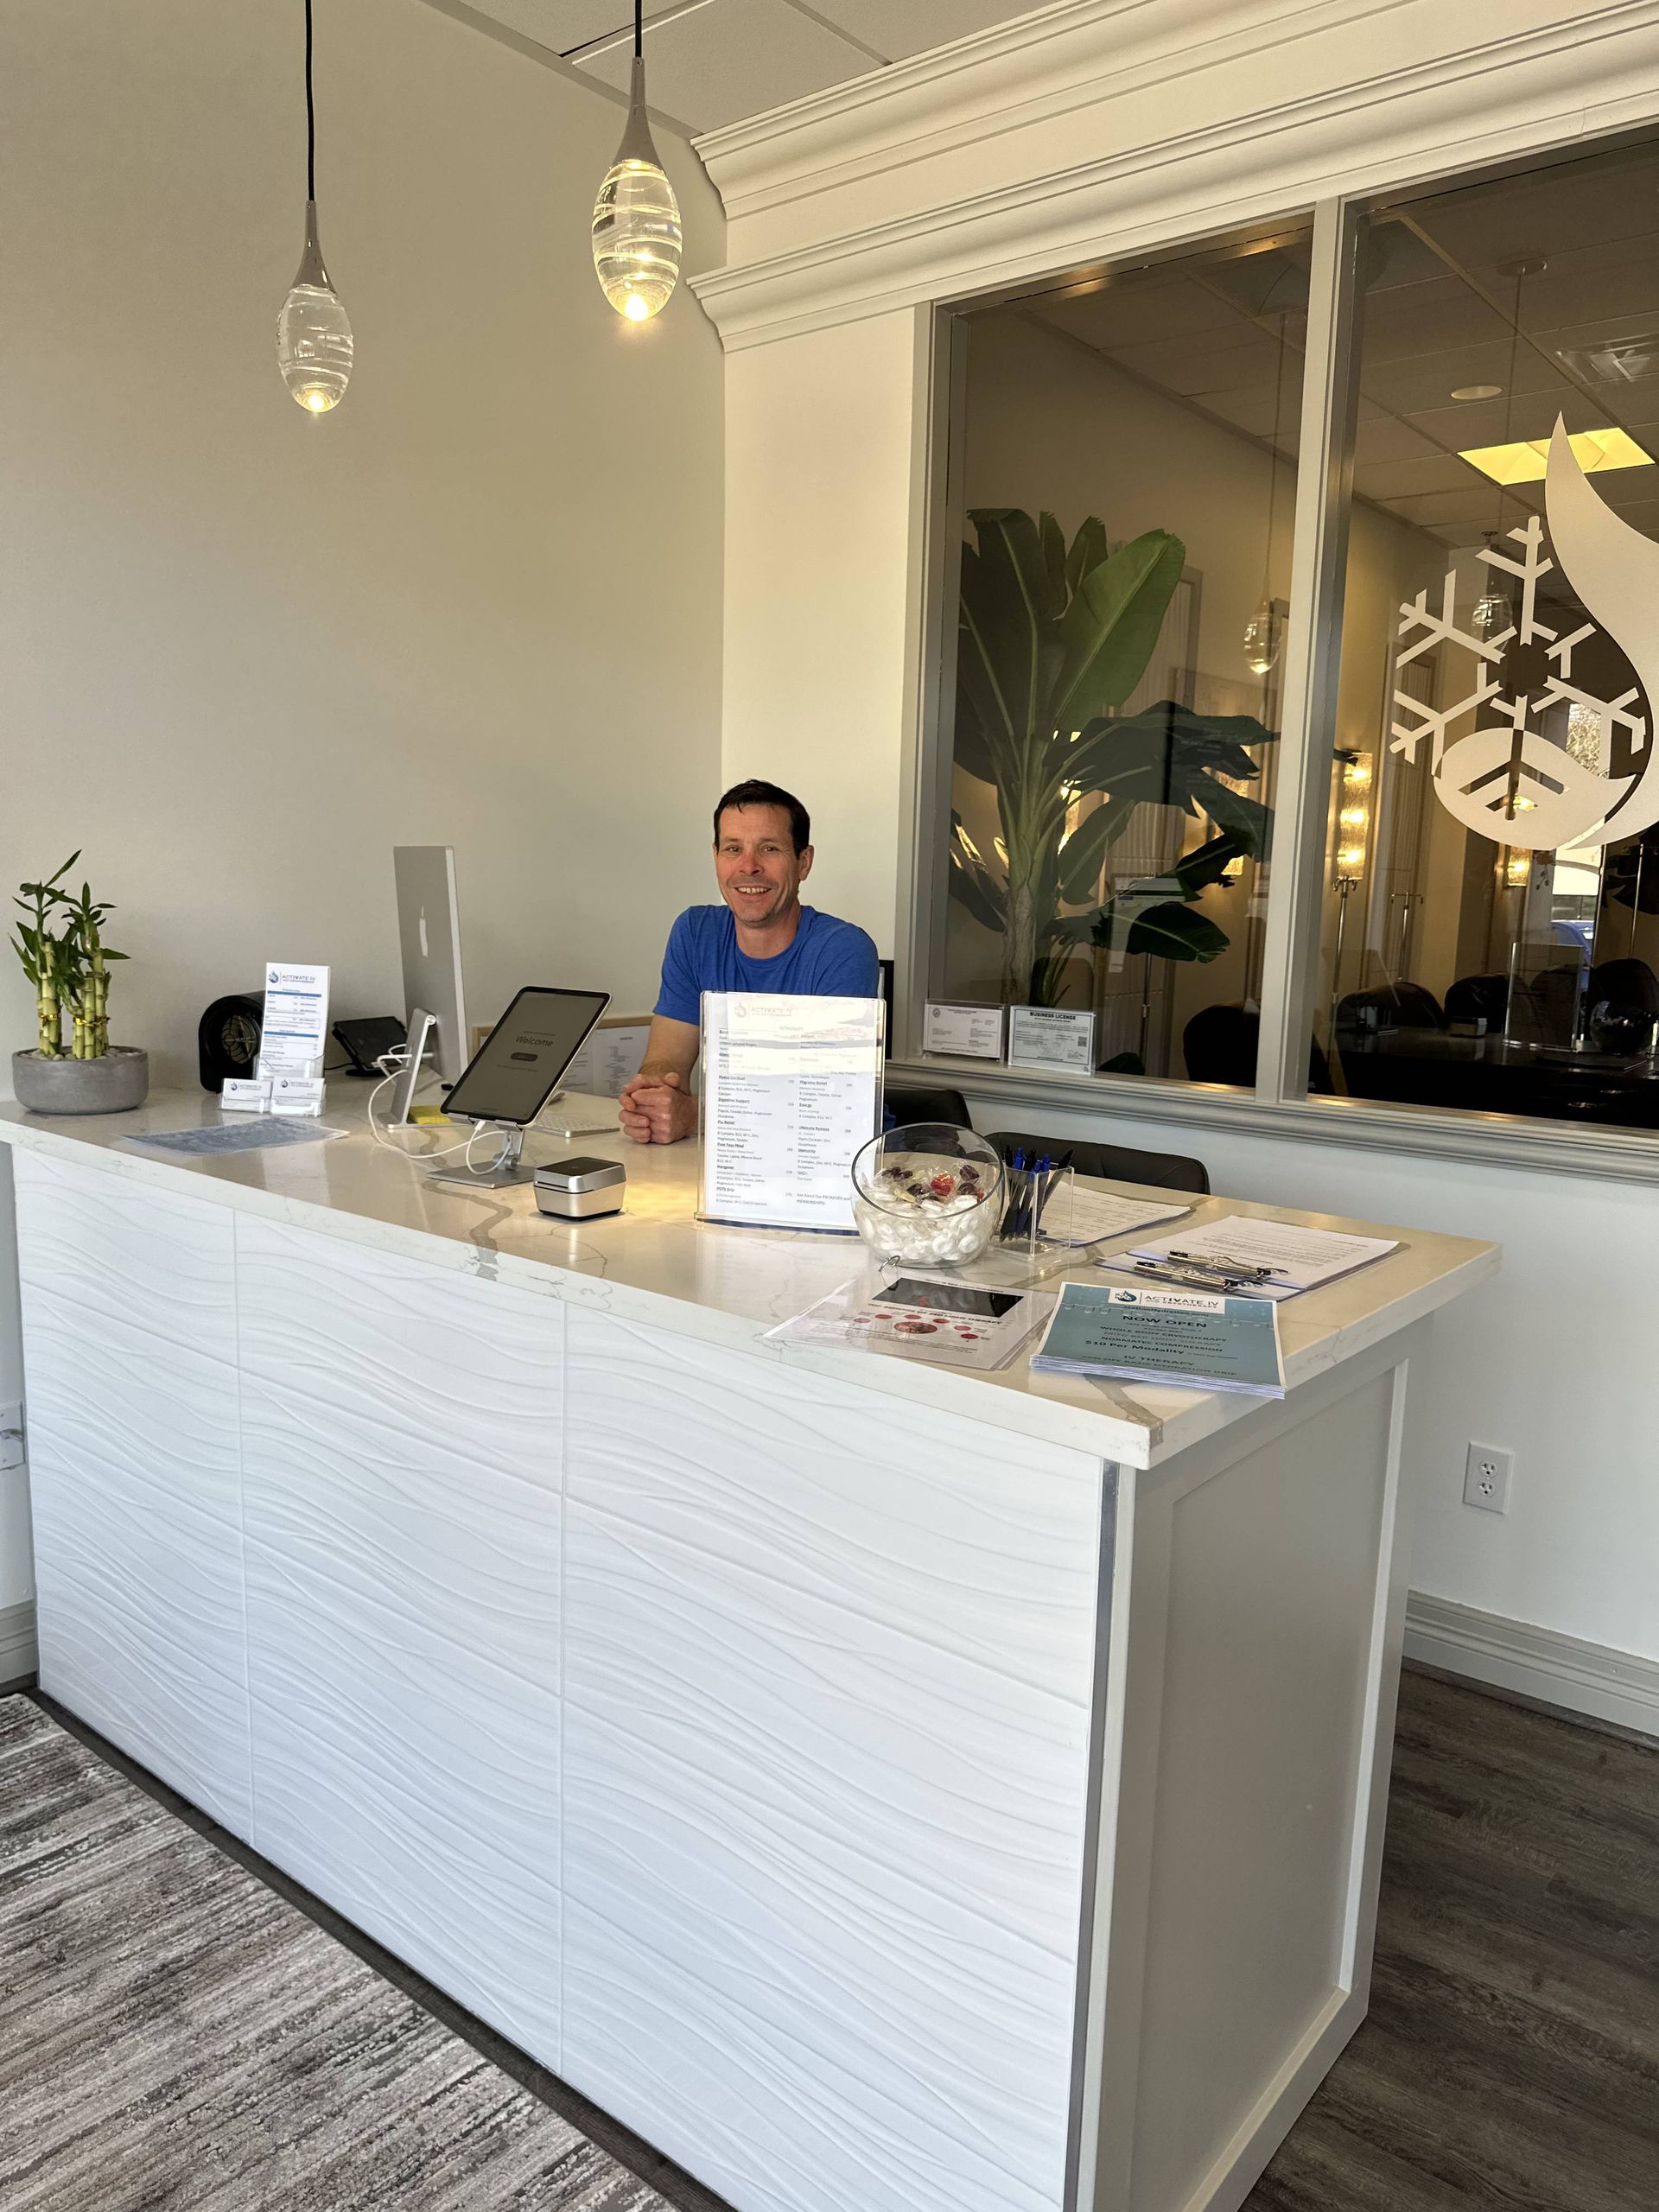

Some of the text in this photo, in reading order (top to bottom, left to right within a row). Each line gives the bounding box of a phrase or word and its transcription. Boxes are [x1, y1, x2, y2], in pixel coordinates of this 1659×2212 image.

[516, 1036, 553, 1046] Welcome
[1145, 1295, 1203, 1304] ACTIVATE
[1162, 1332, 1227, 1342] CRYOTHERAPY
[1132, 1345, 1184, 1355] Modality
[1155, 1342, 1223, 1352] COMPRESSION
[1139, 1357, 1196, 1366] THERAPY
[1154, 1364, 1210, 1372] HYDRATION
